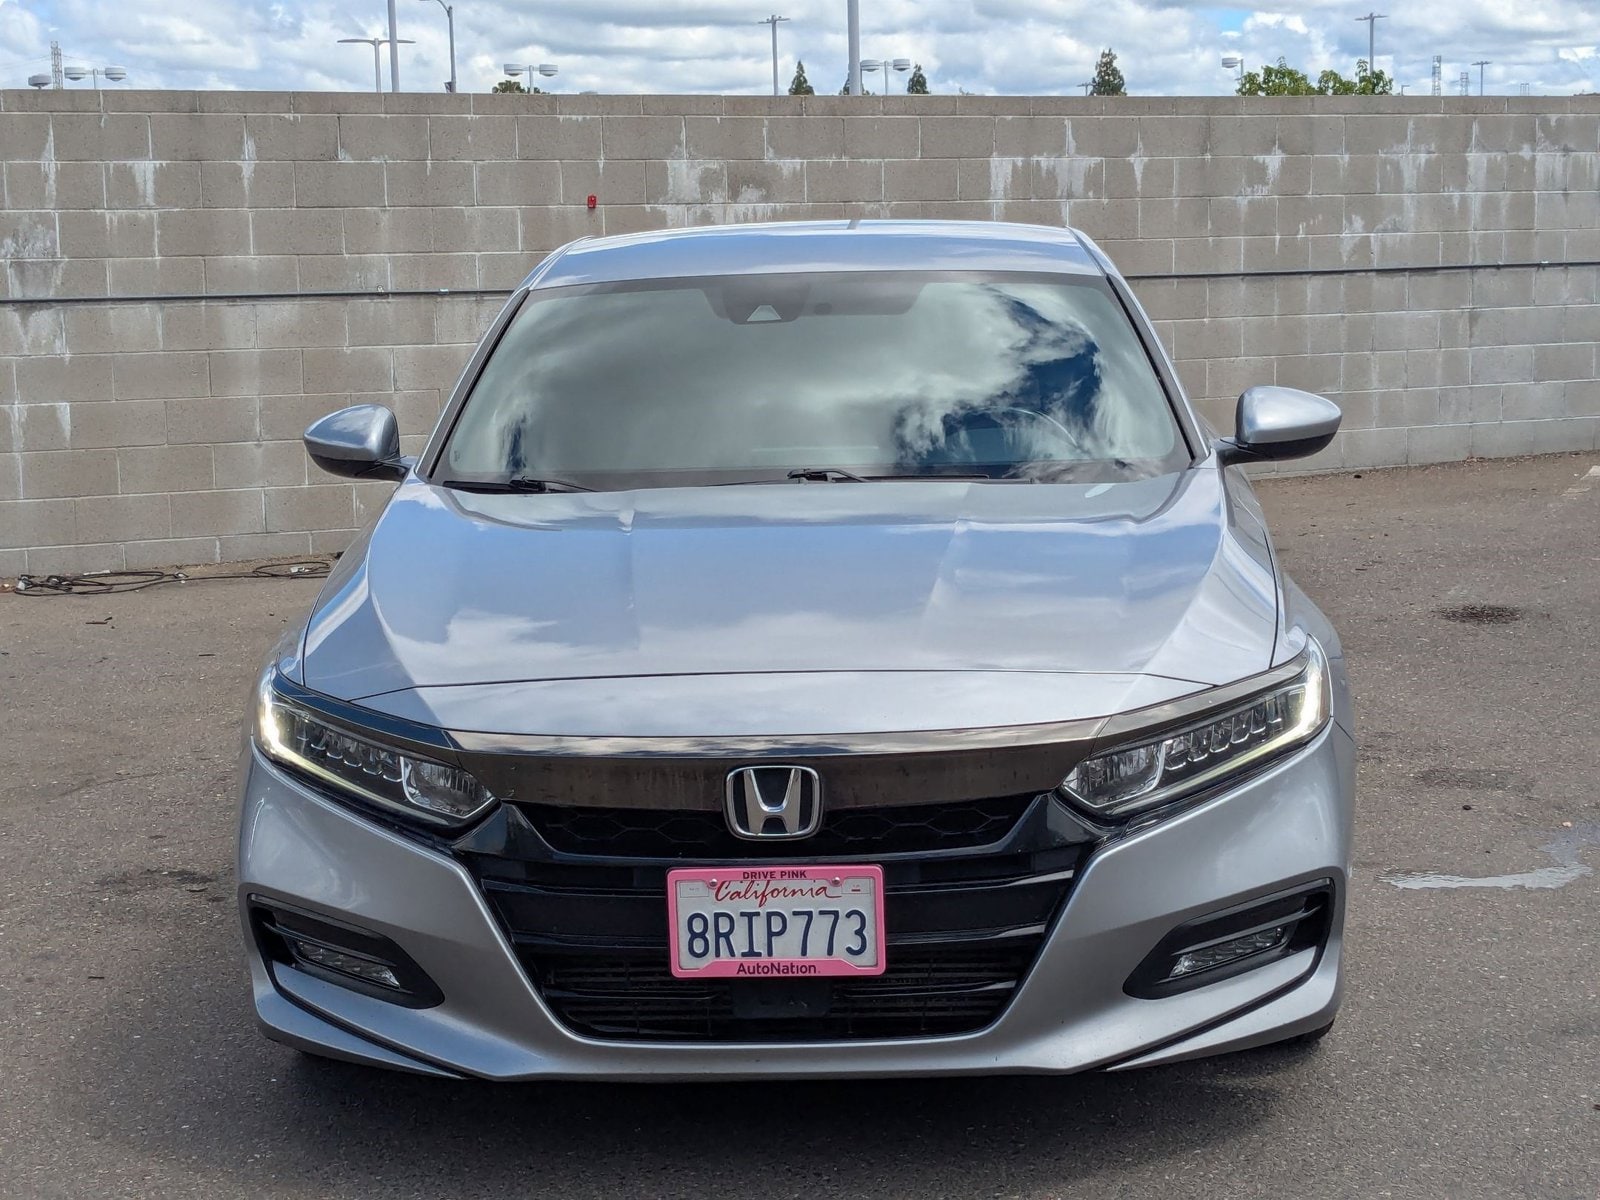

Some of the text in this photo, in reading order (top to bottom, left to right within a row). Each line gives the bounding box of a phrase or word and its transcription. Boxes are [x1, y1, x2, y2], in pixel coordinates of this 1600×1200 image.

[742, 870, 807, 880] DRIVE PINK
[714, 880, 842, 907] California
[687, 909, 867, 958] 8RIP773
[736, 962, 817, 975] AutoNation
